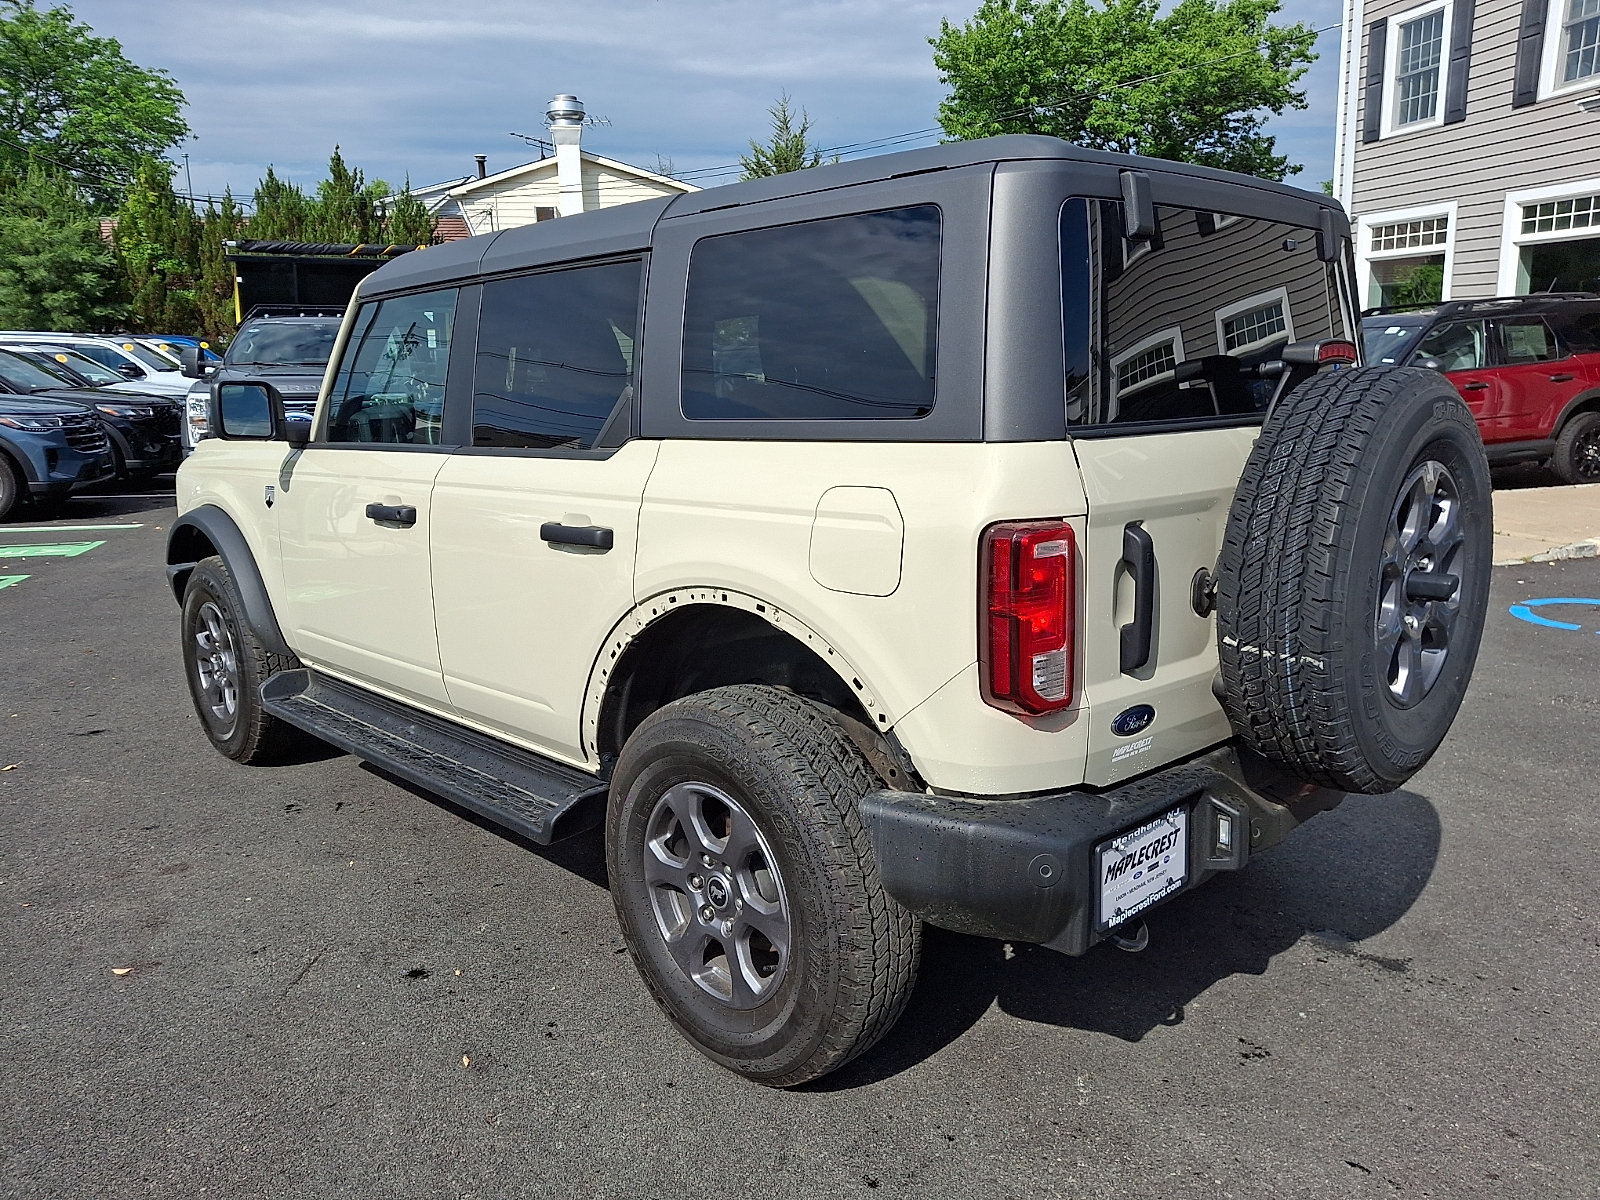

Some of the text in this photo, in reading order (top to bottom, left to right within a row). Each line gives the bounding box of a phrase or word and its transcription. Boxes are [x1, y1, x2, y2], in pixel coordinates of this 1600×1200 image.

[1124, 714, 1148, 732] Ford
[1166, 807, 1180, 820] NJ
[1103, 827, 1181, 886] MAPLECREST
[1108, 879, 1182, 929] MaplecrestFord.com
